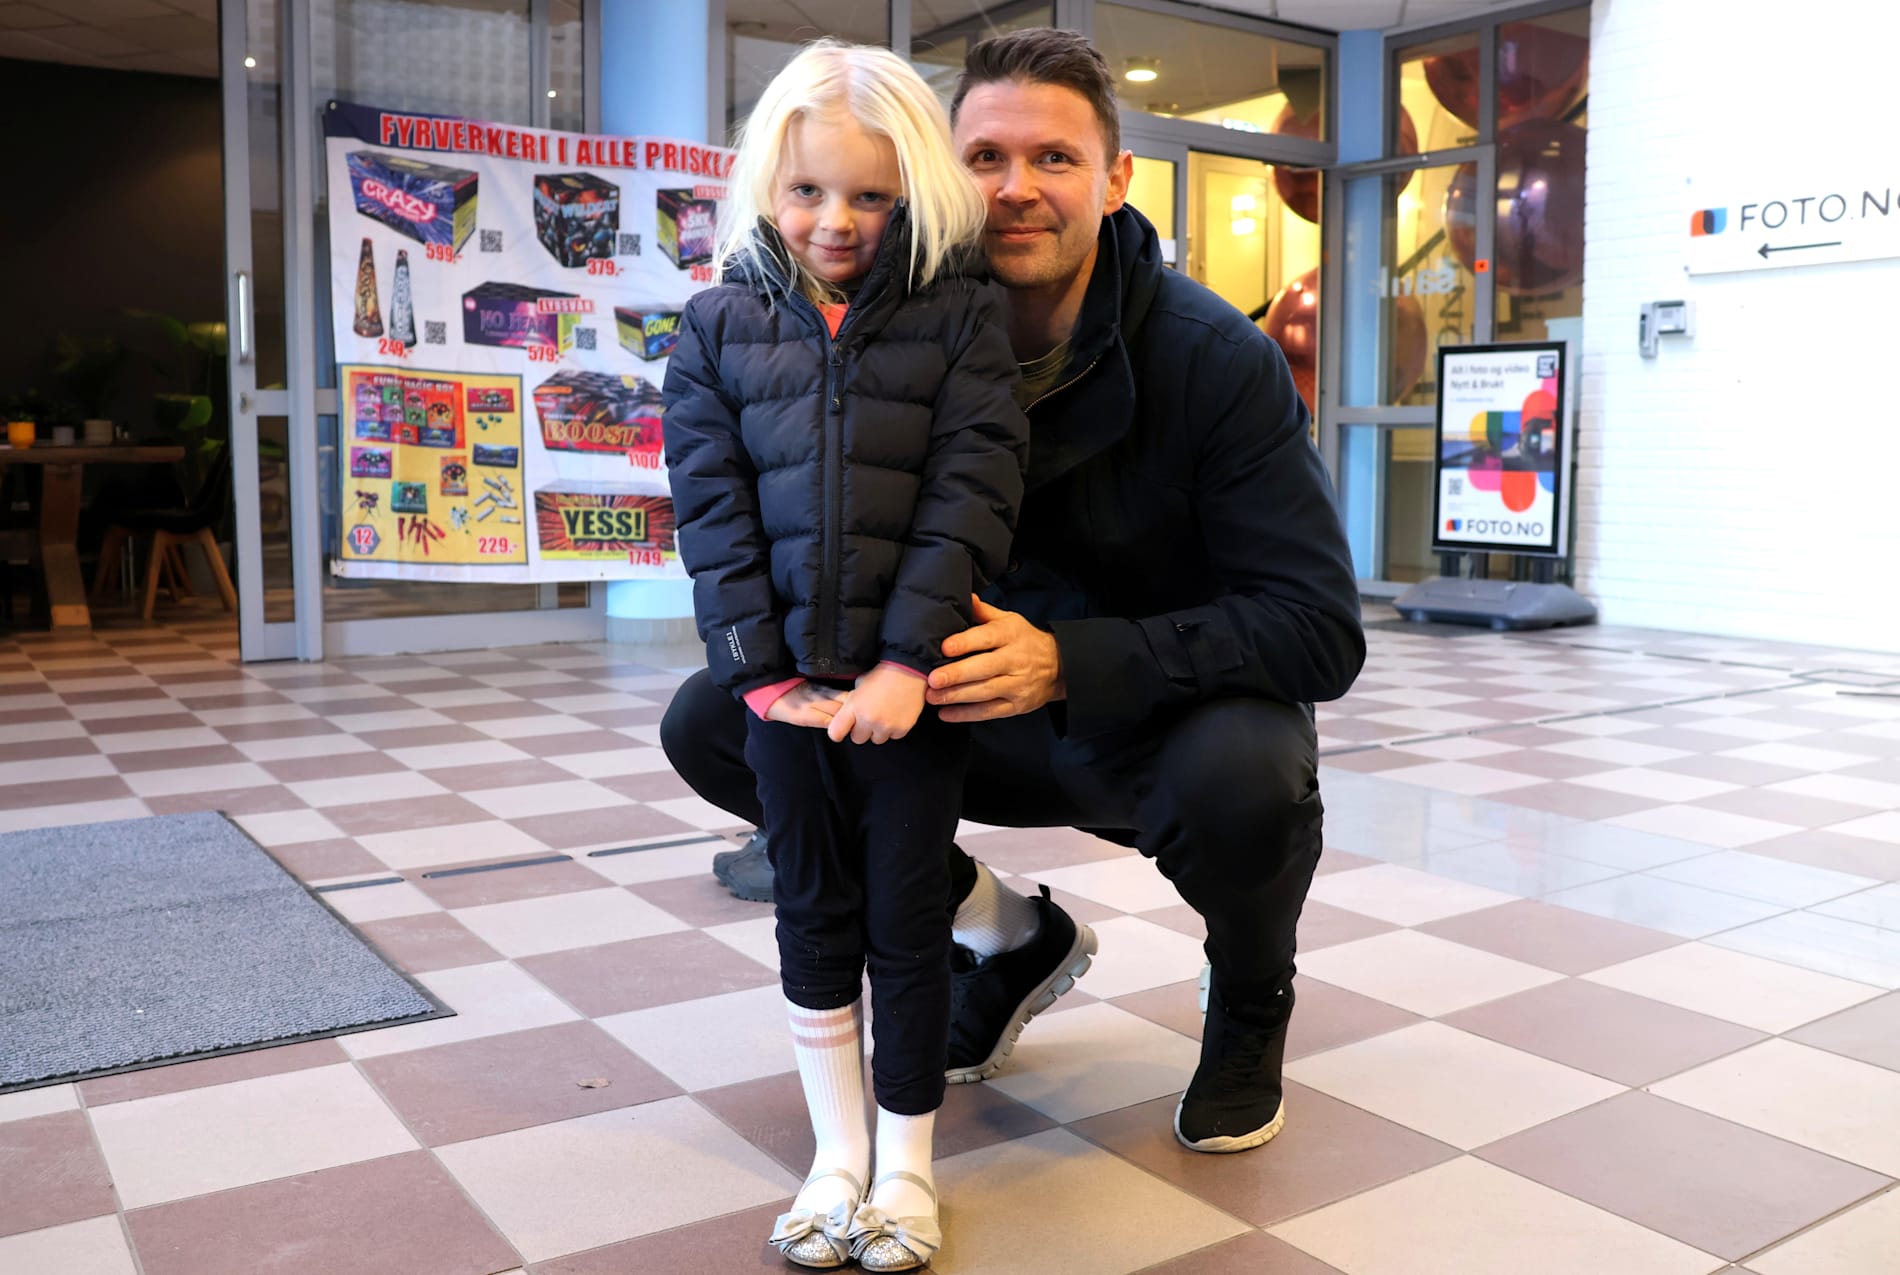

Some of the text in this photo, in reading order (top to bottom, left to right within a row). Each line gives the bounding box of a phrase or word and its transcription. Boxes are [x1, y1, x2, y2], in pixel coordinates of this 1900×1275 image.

[380, 113, 549, 162] FYRVERKERI
[558, 137, 567, 164] I
[576, 139, 636, 168] ALLE
[362, 179, 437, 222] CRAZY
[1741, 188, 1900, 232] FOTO.N
[544, 419, 641, 446] BOOST
[354, 527, 373, 545] 12
[563, 509, 642, 536] YESS!
[1467, 519, 1544, 537] FOTO.NO
